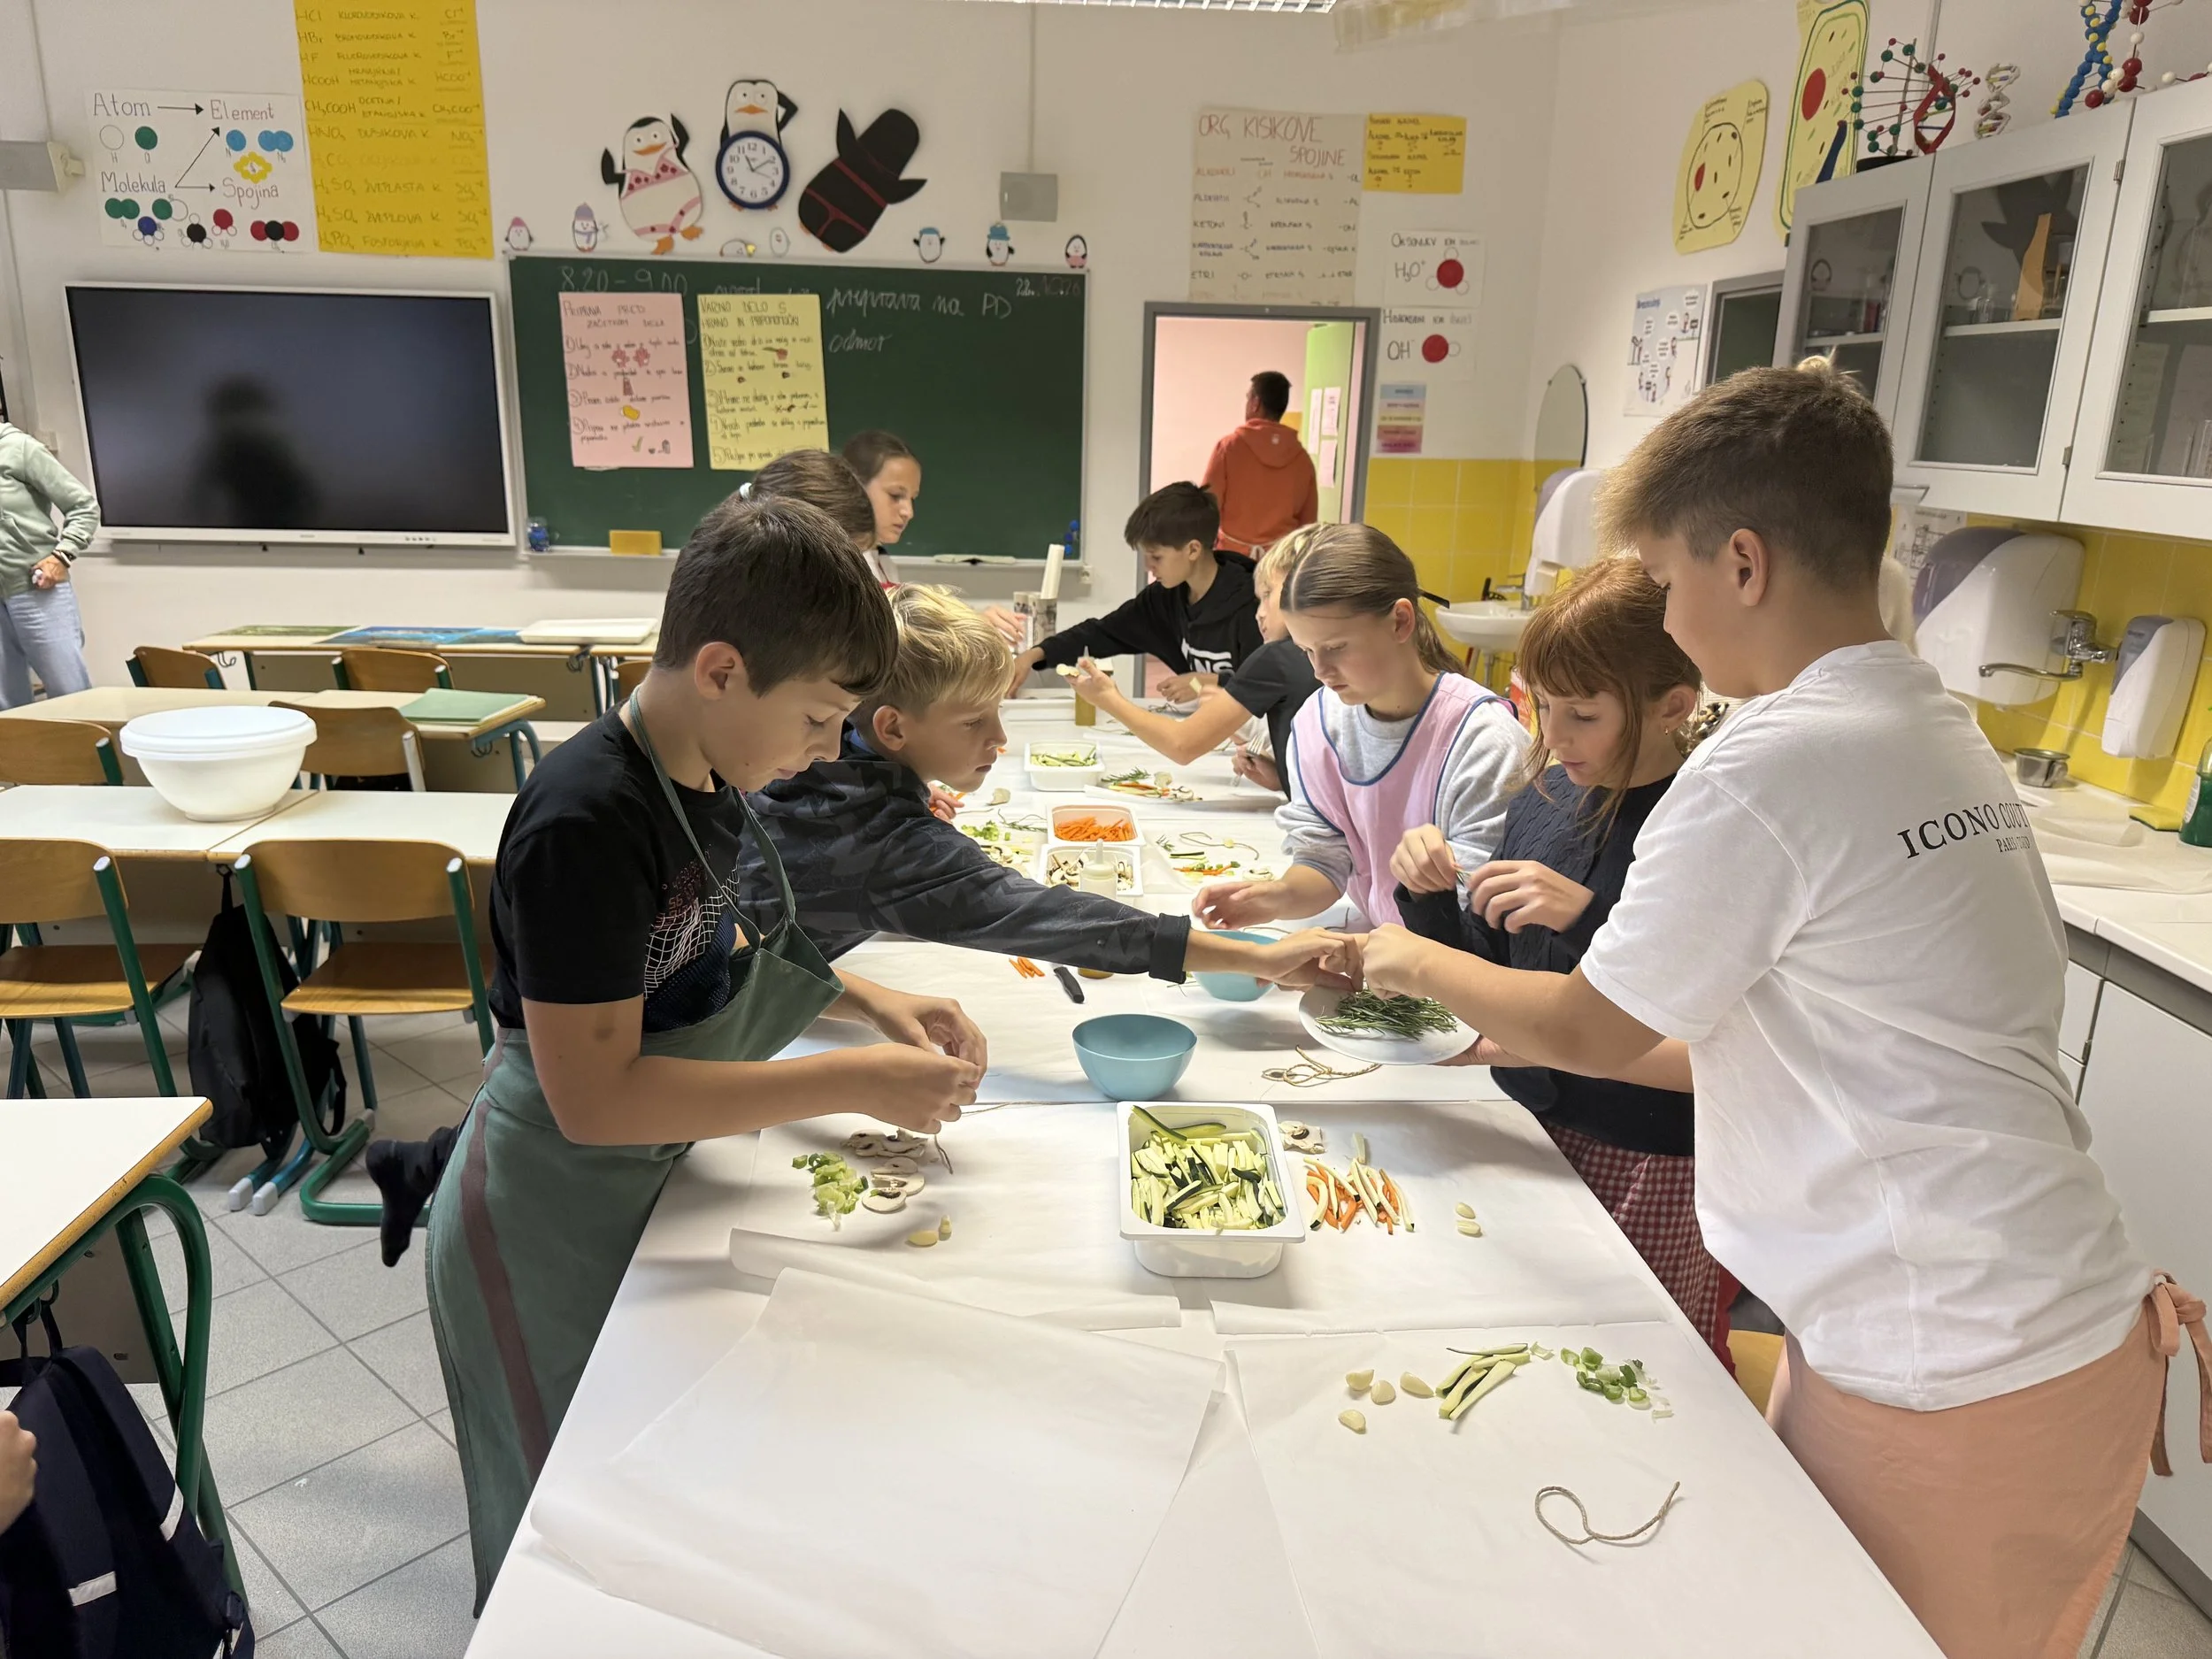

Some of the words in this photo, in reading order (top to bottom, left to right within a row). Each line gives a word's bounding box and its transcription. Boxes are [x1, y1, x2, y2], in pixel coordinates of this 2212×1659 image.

[93, 92, 151, 117] Atom
[210, 99, 274, 121] Element
[1243, 115, 1324, 143] KISIKOVE
[737, 145, 746, 155] 11
[747, 142, 757, 151] 12
[763, 146, 767, 156] 1
[729, 154, 741, 164] 10
[768, 155, 776, 165] 2
[1289, 144, 1347, 168] SPOJINE
[726, 165, 734, 174] 9
[772, 166, 780, 176] 3
[100, 171, 166, 194] Molekula
[731, 177, 738, 186] 8
[222, 177, 280, 211] Spojina
[740, 185, 746, 196] 7
[750, 189, 758, 199] 6
[762, 187, 769, 196] 5
[1897, 803, 1999, 858] ICONO
